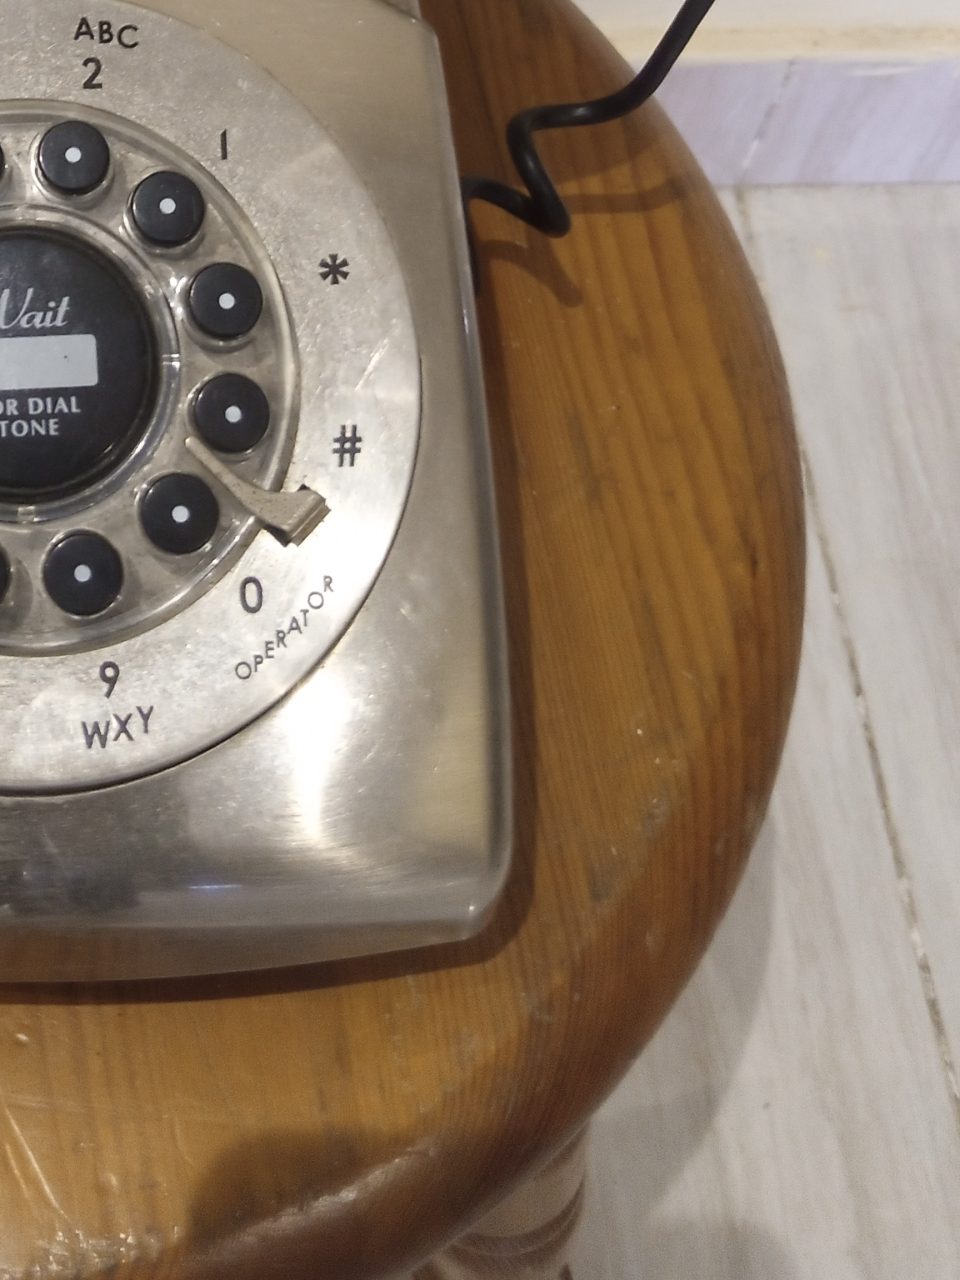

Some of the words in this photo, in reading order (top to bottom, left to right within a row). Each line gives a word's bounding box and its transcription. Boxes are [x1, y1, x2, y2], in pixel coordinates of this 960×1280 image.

[73, 17, 140, 49] ABC
[81, 56, 103, 90] 2
[28, 396, 81, 414] DIAL
[234, 575, 334, 680] OPERATOR
[98, 661, 121, 698] 9
[81, 705, 154, 750] WXY
